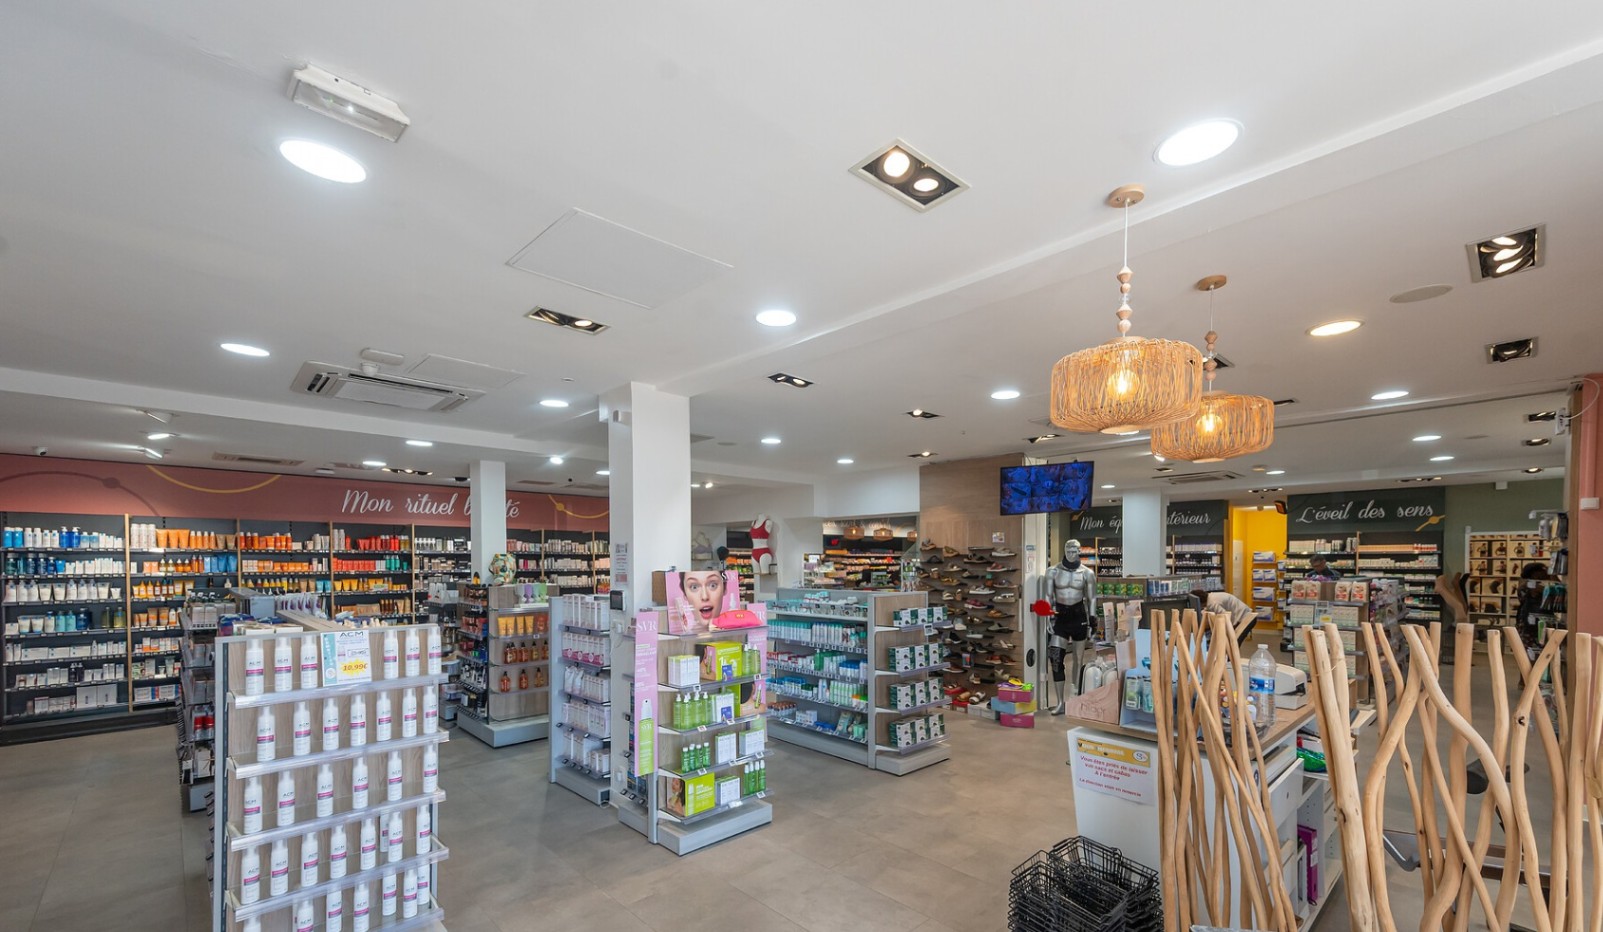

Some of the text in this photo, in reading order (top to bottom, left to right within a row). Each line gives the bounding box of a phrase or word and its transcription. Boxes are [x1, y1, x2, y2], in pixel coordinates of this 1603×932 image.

[342, 490, 520, 518] Mon rituel bté
[1296, 500, 1433, 523] L'éveil des sens
[1080, 516, 1104, 531] Mon
